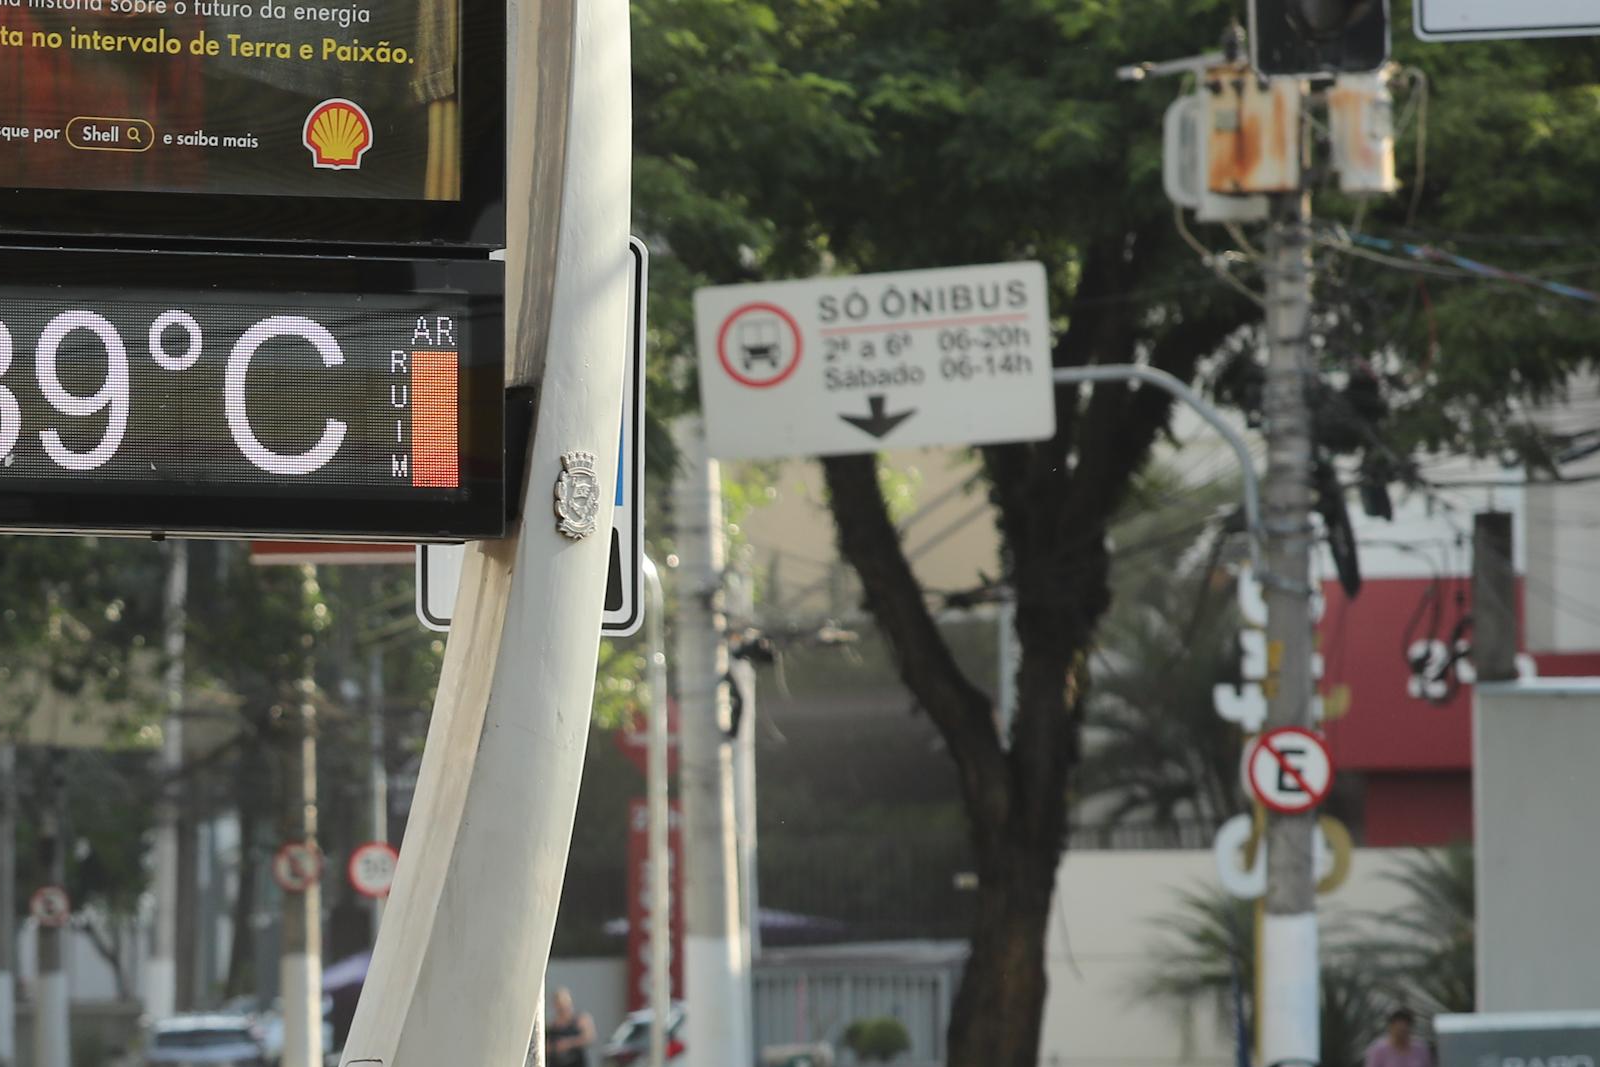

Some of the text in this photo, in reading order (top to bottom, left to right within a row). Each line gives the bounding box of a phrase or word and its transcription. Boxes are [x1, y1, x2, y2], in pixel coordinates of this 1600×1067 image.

[110, 0, 167, 14] sobre
[174, 1, 187, 15] o
[194, 0, 252, 18] futuro
[260, 0, 286, 19] da
[294, 6, 371, 28] energia
[32, 31, 63, 49] no
[70, 26, 182, 54] intervalo
[189, 30, 220, 56] de
[227, 34, 291, 59] Terra
[299, 43, 314, 60] e
[322, 38, 415, 65] Paixão.
[33, 126, 61, 143] por
[82, 125, 120, 143] Shell
[163, 133, 173, 145] e
[176, 130, 219, 147] saiba
[222, 132, 259, 149] mais
[881, 279, 1029, 316] ÔNIBUS
[411, 316, 456, 345] AR
[860, 339, 876, 358] a
[939, 354, 1033, 381] 06-14h
[391, 350, 407, 477] RUIM
